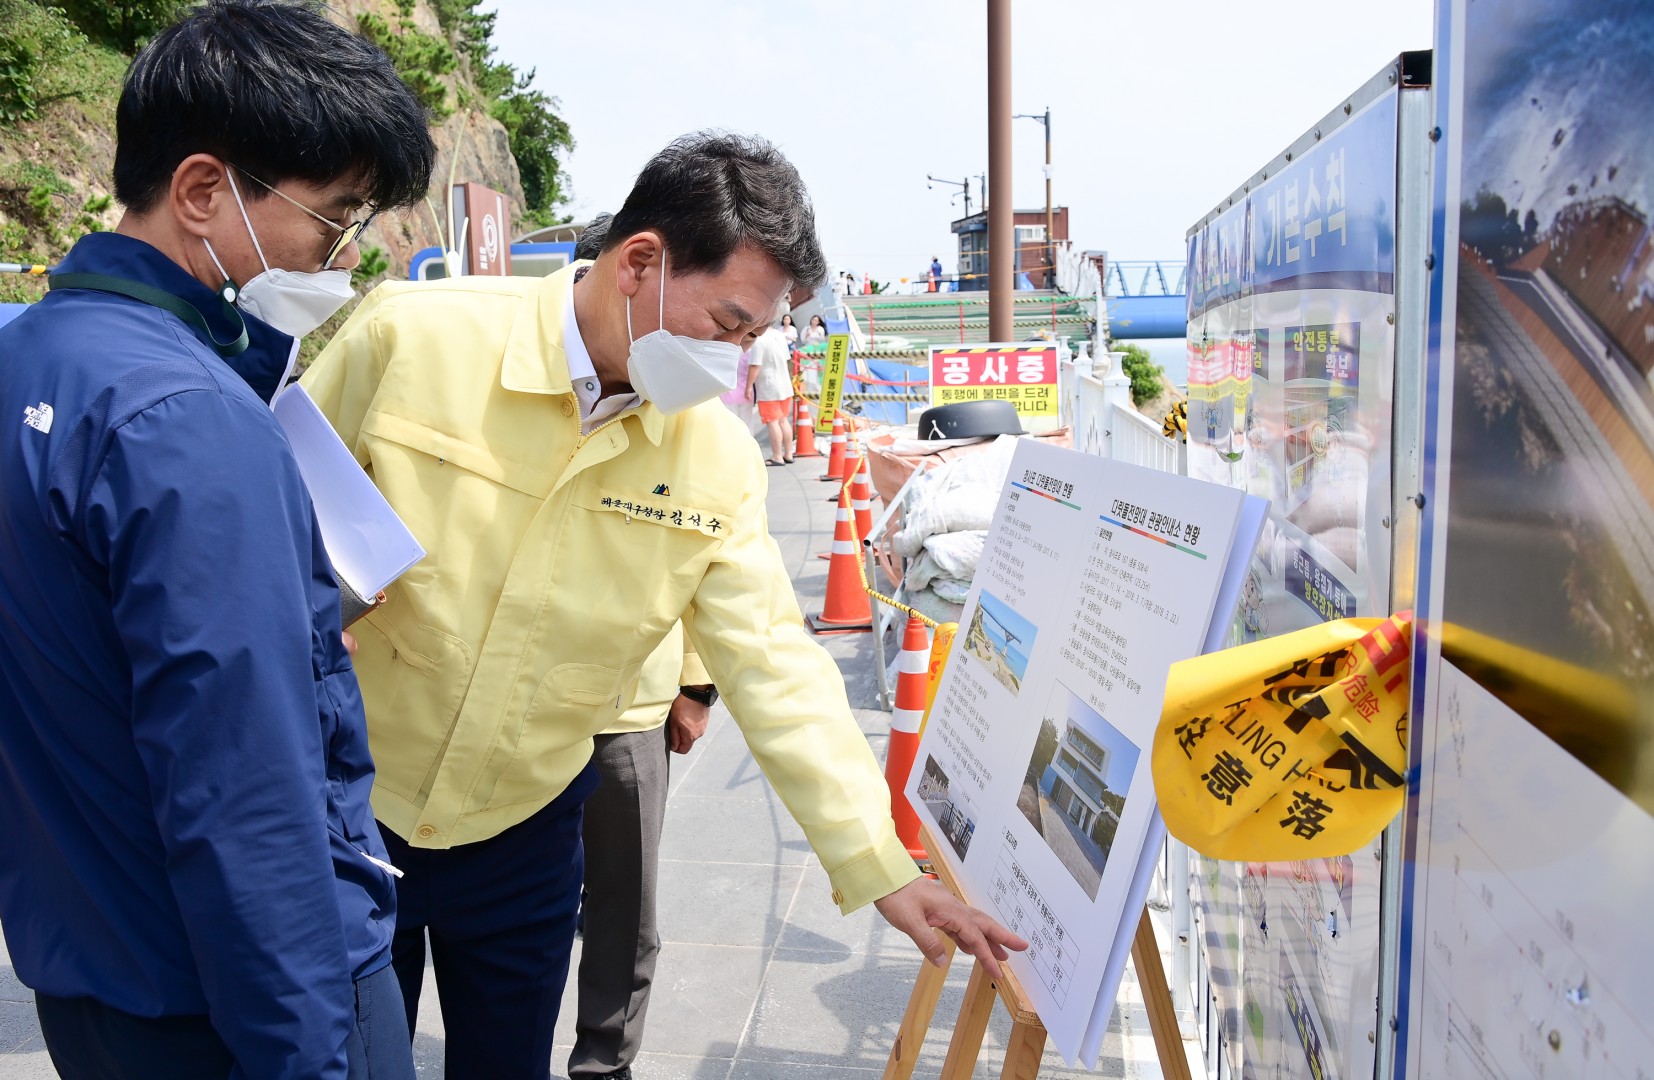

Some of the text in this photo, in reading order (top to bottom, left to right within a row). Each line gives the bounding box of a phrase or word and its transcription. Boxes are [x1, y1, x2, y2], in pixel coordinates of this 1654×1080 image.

[829, 340, 842, 374] 보행자
[942, 355, 1045, 384] 공사중
[942, 387, 1049, 400] 통행에 불편을 드려
[1062, 483, 1073, 499] 현황
[601, 497, 666, 521] 해운대구청장
[1112, 500, 1200, 545] 다릿돌전망대 관광안내소 현황
[1339, 673, 1379, 723] 危险
